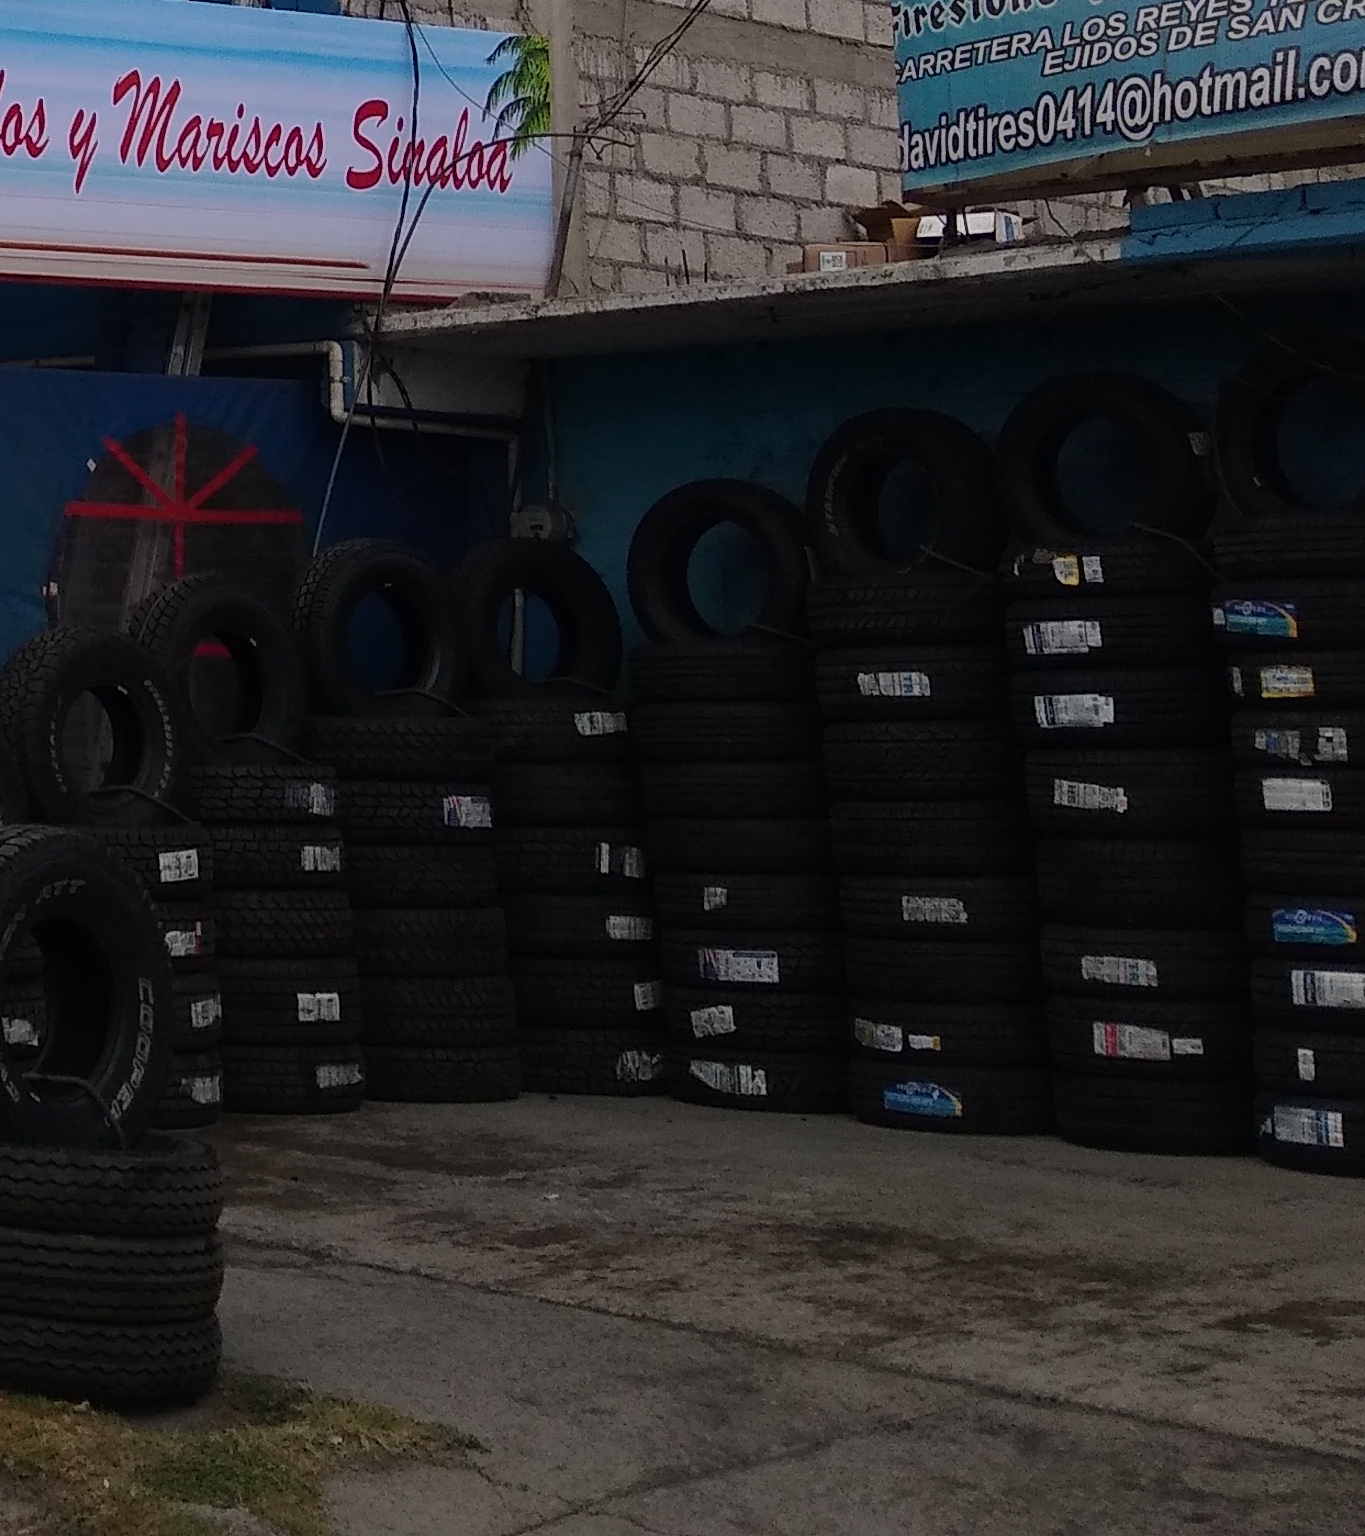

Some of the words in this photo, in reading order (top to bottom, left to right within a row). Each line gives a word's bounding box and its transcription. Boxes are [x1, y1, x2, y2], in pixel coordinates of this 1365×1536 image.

[1042, 30, 1159, 77] EJIDOS
[1167, 21, 1218, 54] DE
[1227, 4, 1307, 41] SAN
[1060, 10, 1128, 48] LOS
[68, 102, 98, 195] y
[111, 67, 328, 180] Mariscos
[345, 98, 513, 195] Sinaloa
[897, 47, 1365, 172] davidtires0414@hotmail.co
